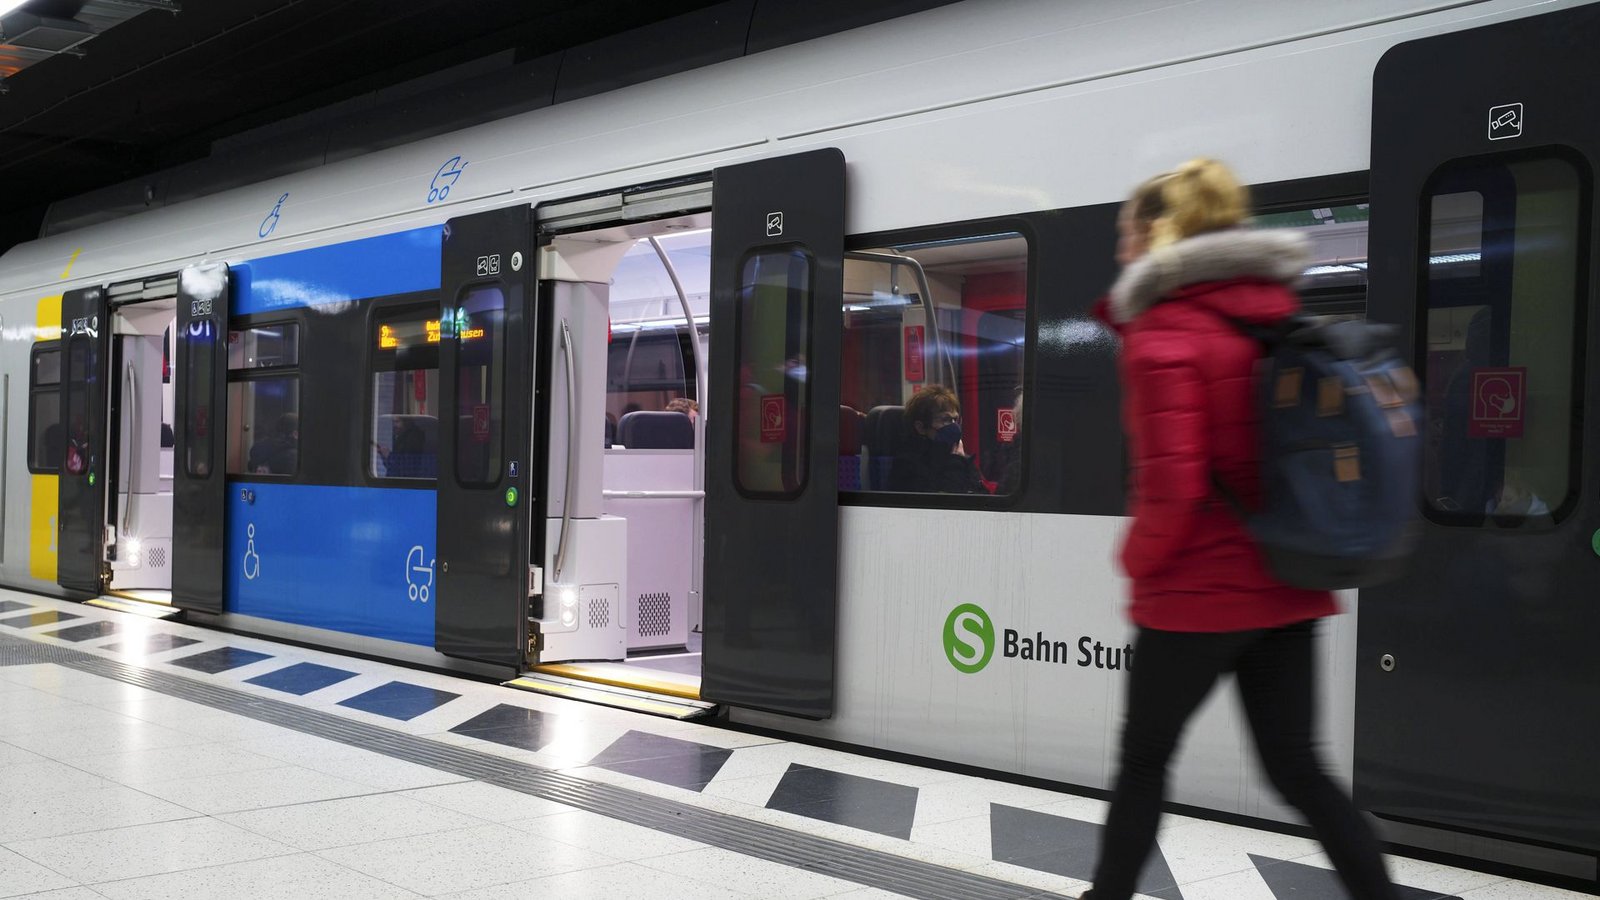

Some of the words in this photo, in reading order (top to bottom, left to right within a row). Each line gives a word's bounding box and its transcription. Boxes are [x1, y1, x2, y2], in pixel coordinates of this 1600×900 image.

[950, 609, 988, 668] S
[1003, 628, 1068, 664] Bahn
[1076, 635, 1134, 672] Stut
